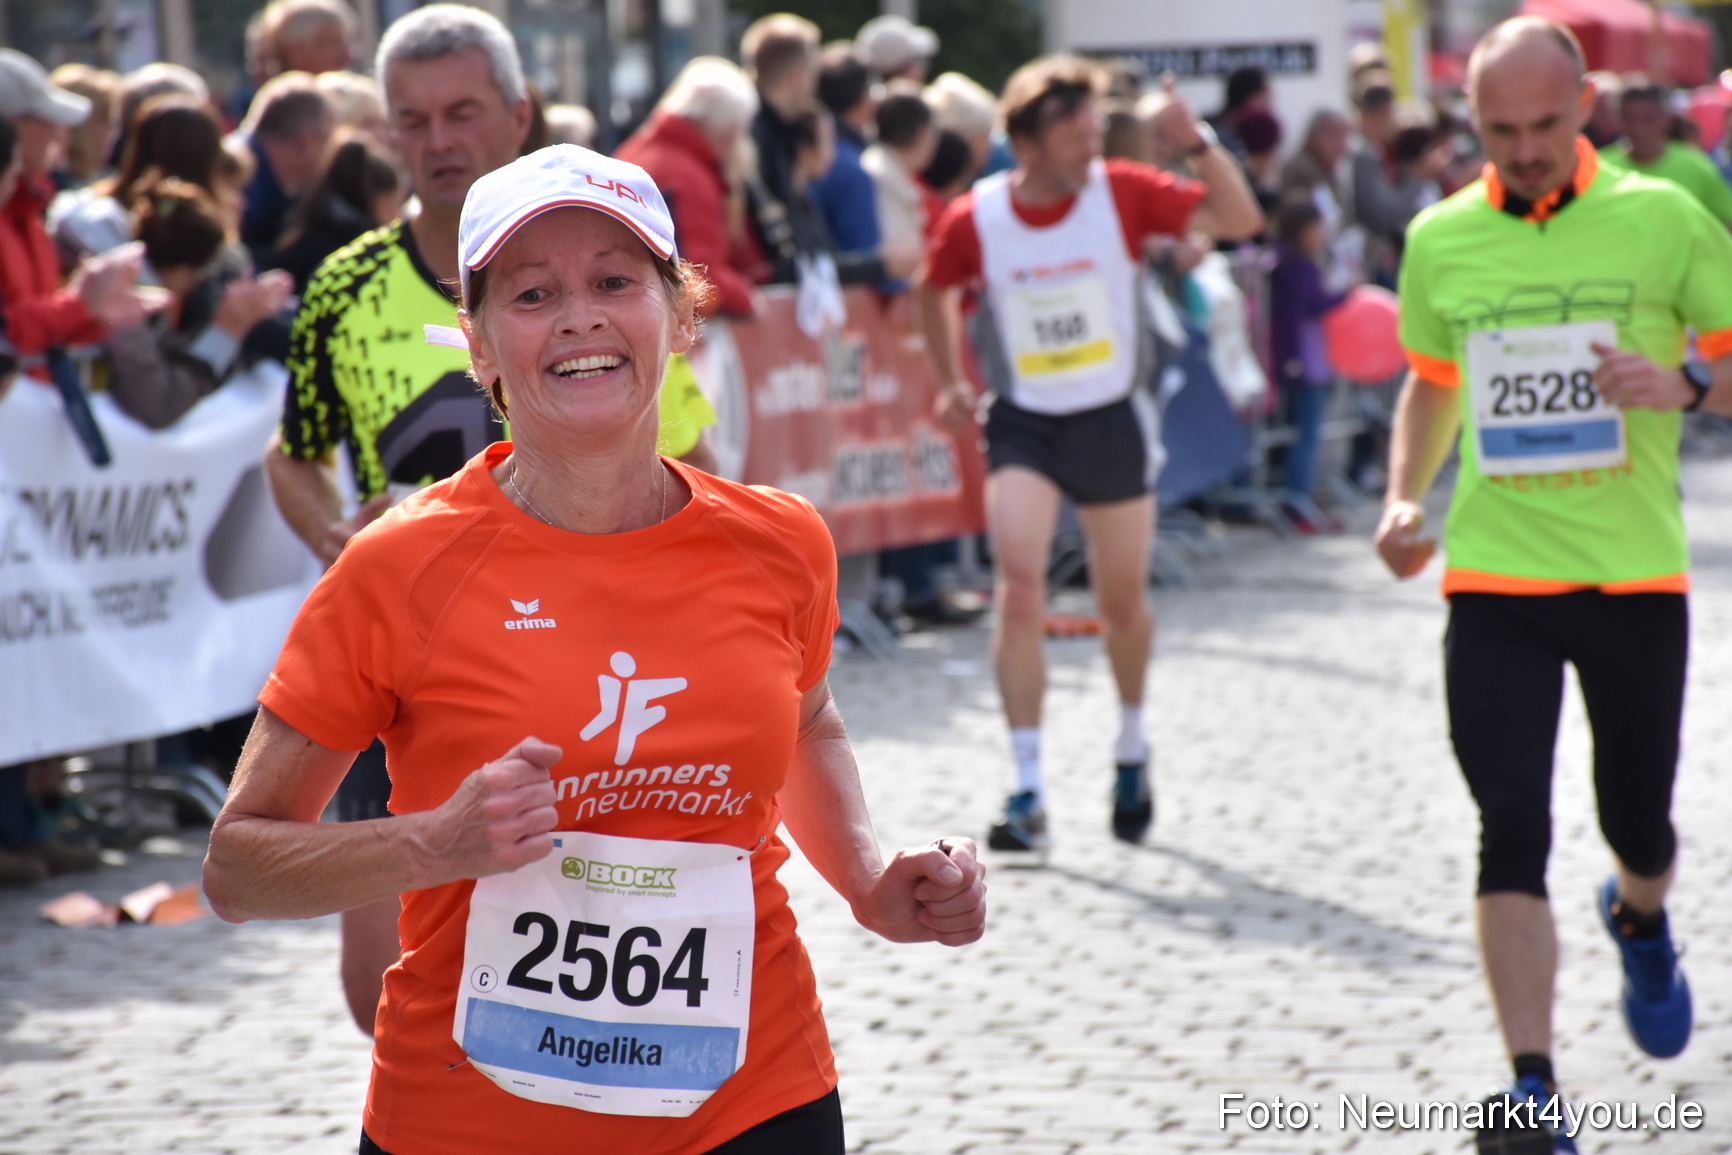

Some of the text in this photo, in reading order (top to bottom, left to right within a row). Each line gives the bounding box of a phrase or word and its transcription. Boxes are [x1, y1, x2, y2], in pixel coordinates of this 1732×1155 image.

[1489, 369, 1596, 417] 2528
[504, 617, 557, 630] erima
[550, 764, 732, 801] nrunners
[575, 788, 752, 821] neumarkt
[587, 860, 678, 889] BOCK
[585, 884, 676, 899] inspired by smart concepts
[506, 911, 709, 1008] 2564
[479, 972, 490, 987] C
[537, 1026, 662, 1067] Angelika
